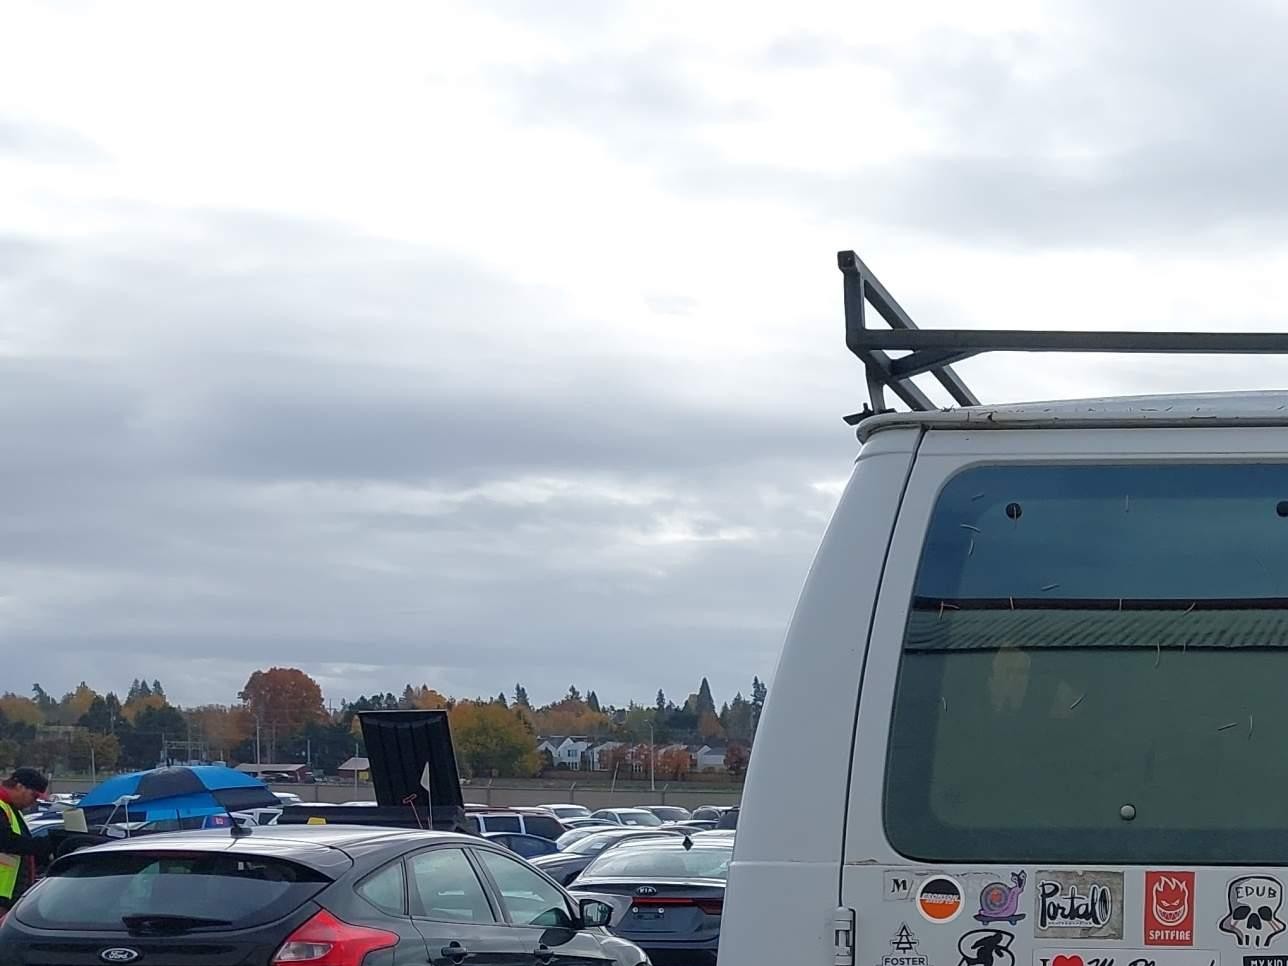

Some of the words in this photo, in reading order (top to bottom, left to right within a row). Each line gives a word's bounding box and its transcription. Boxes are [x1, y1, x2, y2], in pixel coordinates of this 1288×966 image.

[1235, 886, 1278, 899] EDUB
[1149, 930, 1191, 940] SPITFIRE
[884, 957, 925, 966] FOSTER
